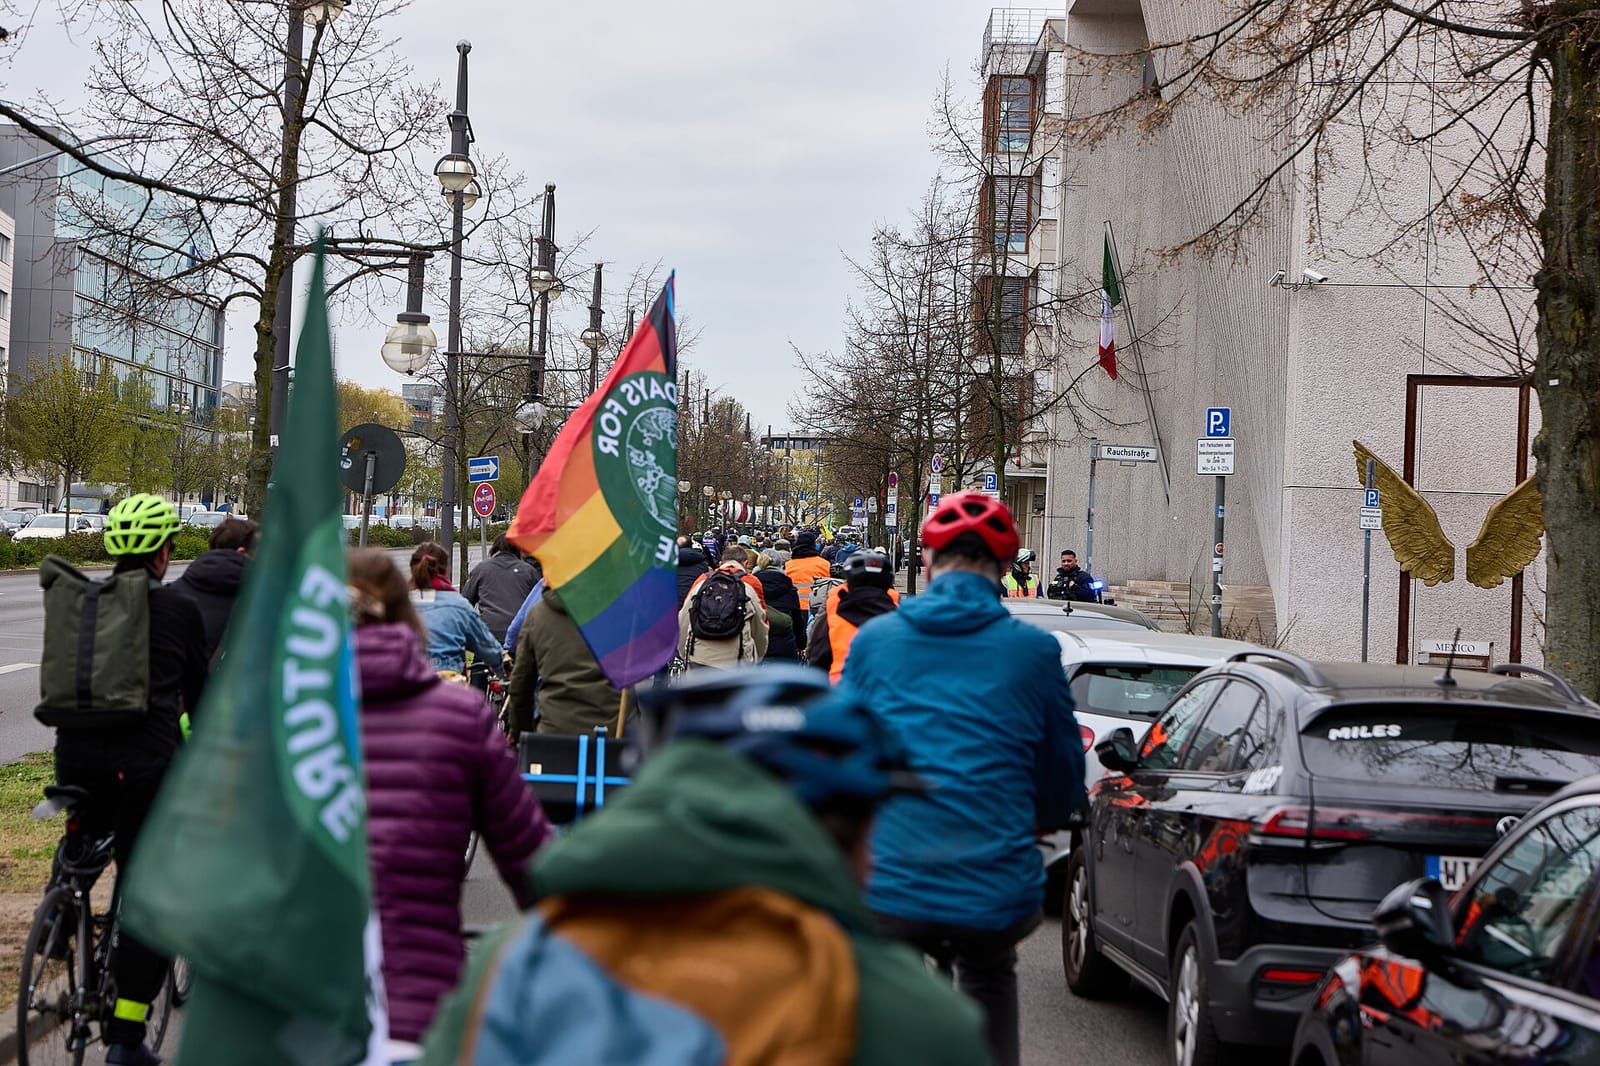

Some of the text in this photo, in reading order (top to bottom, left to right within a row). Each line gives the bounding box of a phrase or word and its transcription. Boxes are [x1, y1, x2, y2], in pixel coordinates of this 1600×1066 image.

[1209, 411, 1224, 434] P
[1106, 447, 1150, 459] Rauchstraße
[1368, 491, 1377, 505] P
[1328, 724, 1402, 741] MILES
